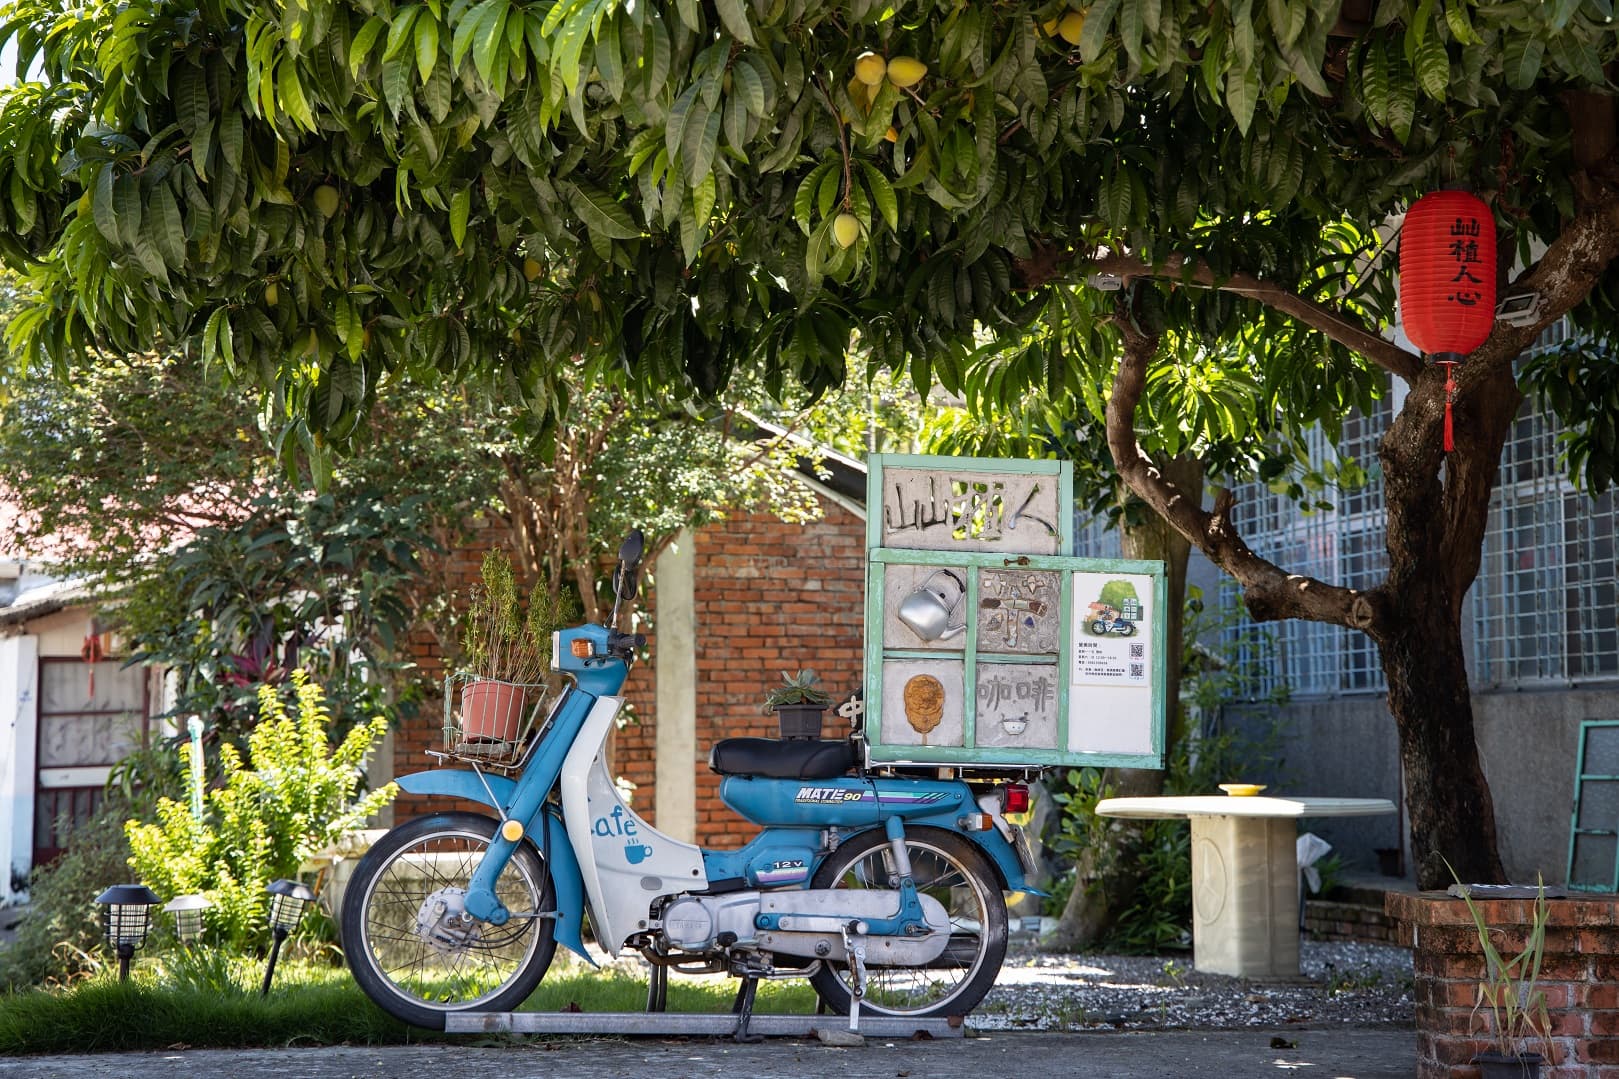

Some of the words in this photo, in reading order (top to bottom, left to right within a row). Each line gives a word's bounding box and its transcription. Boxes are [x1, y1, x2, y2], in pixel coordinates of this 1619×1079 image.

[977, 675, 1056, 712] 咖啡
[796, 787, 846, 800] MATE
[843, 792, 862, 801] 90
[590, 803, 637, 837] afe
